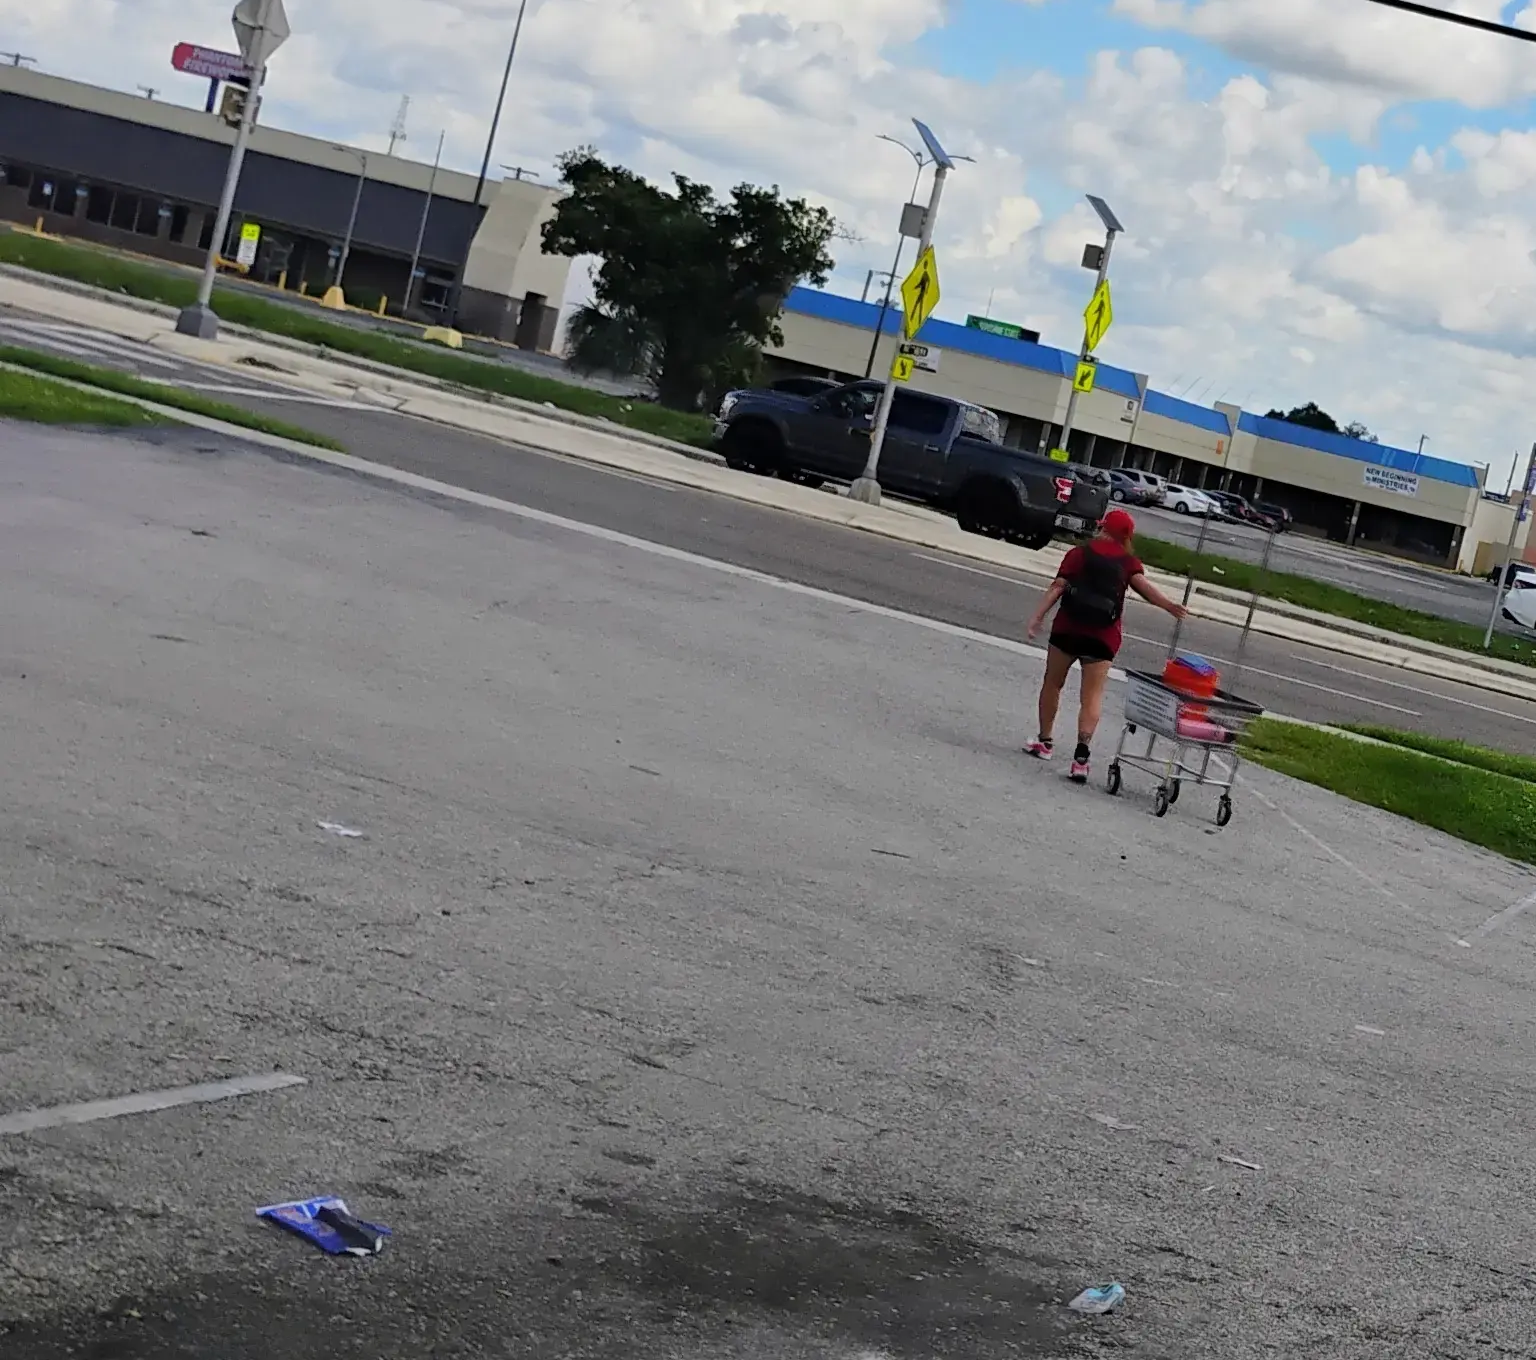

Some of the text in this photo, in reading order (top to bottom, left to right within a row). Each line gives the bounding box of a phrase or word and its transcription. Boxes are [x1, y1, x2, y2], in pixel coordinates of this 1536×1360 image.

[1366, 468, 1417, 485] NEW BEGINNING
[1372, 476, 1408, 490] MINISTRIES
